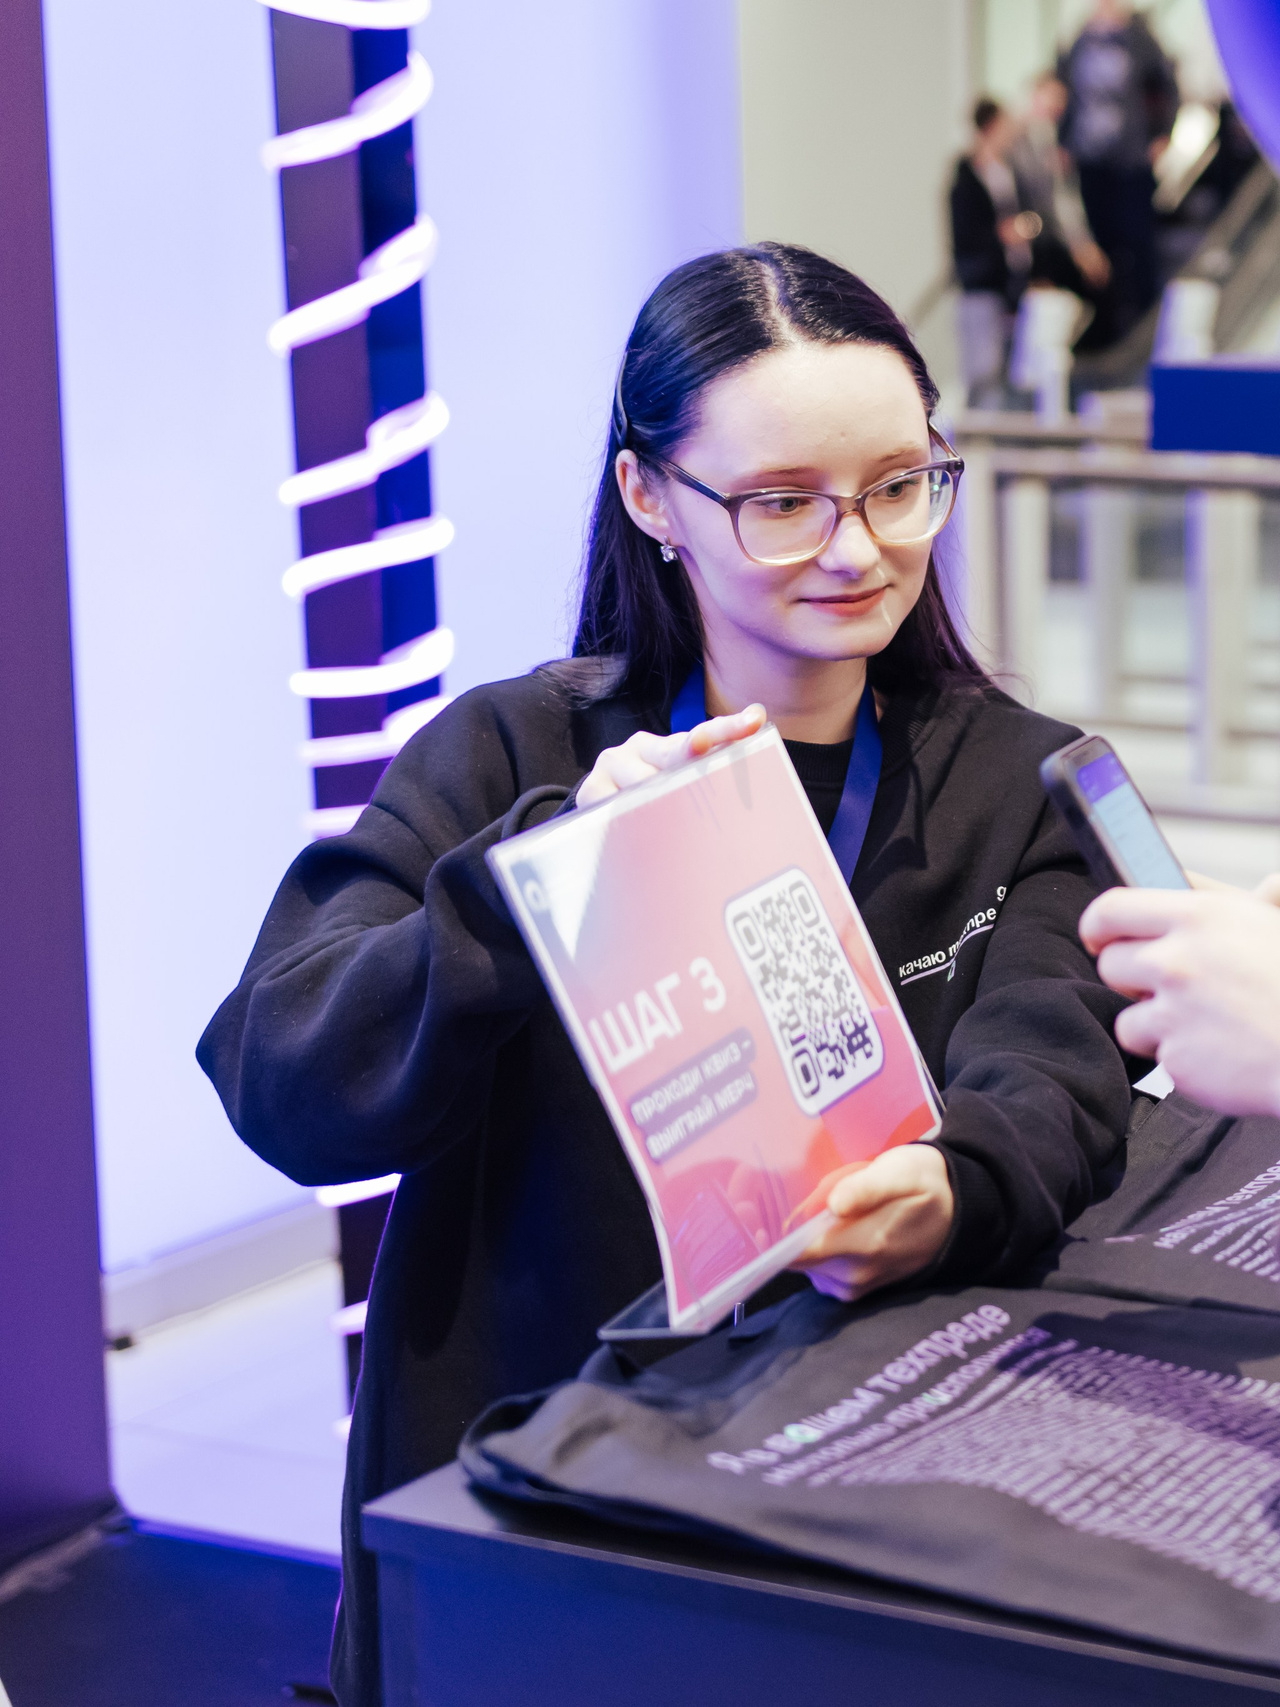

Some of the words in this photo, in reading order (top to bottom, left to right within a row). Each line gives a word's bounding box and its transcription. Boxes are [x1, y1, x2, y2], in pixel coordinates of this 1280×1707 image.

[588, 971, 684, 1075] ШАГ
[688, 956, 727, 1014] 3
[630, 1065, 704, 1125] ПРОХОДИ
[700, 1041, 742, 1080] КВИЗ
[646, 1094, 718, 1160] ВЫИГРАЙ
[713, 1070, 756, 1113] МЕРЧ
[864, 1304, 1011, 1393] техпреде
